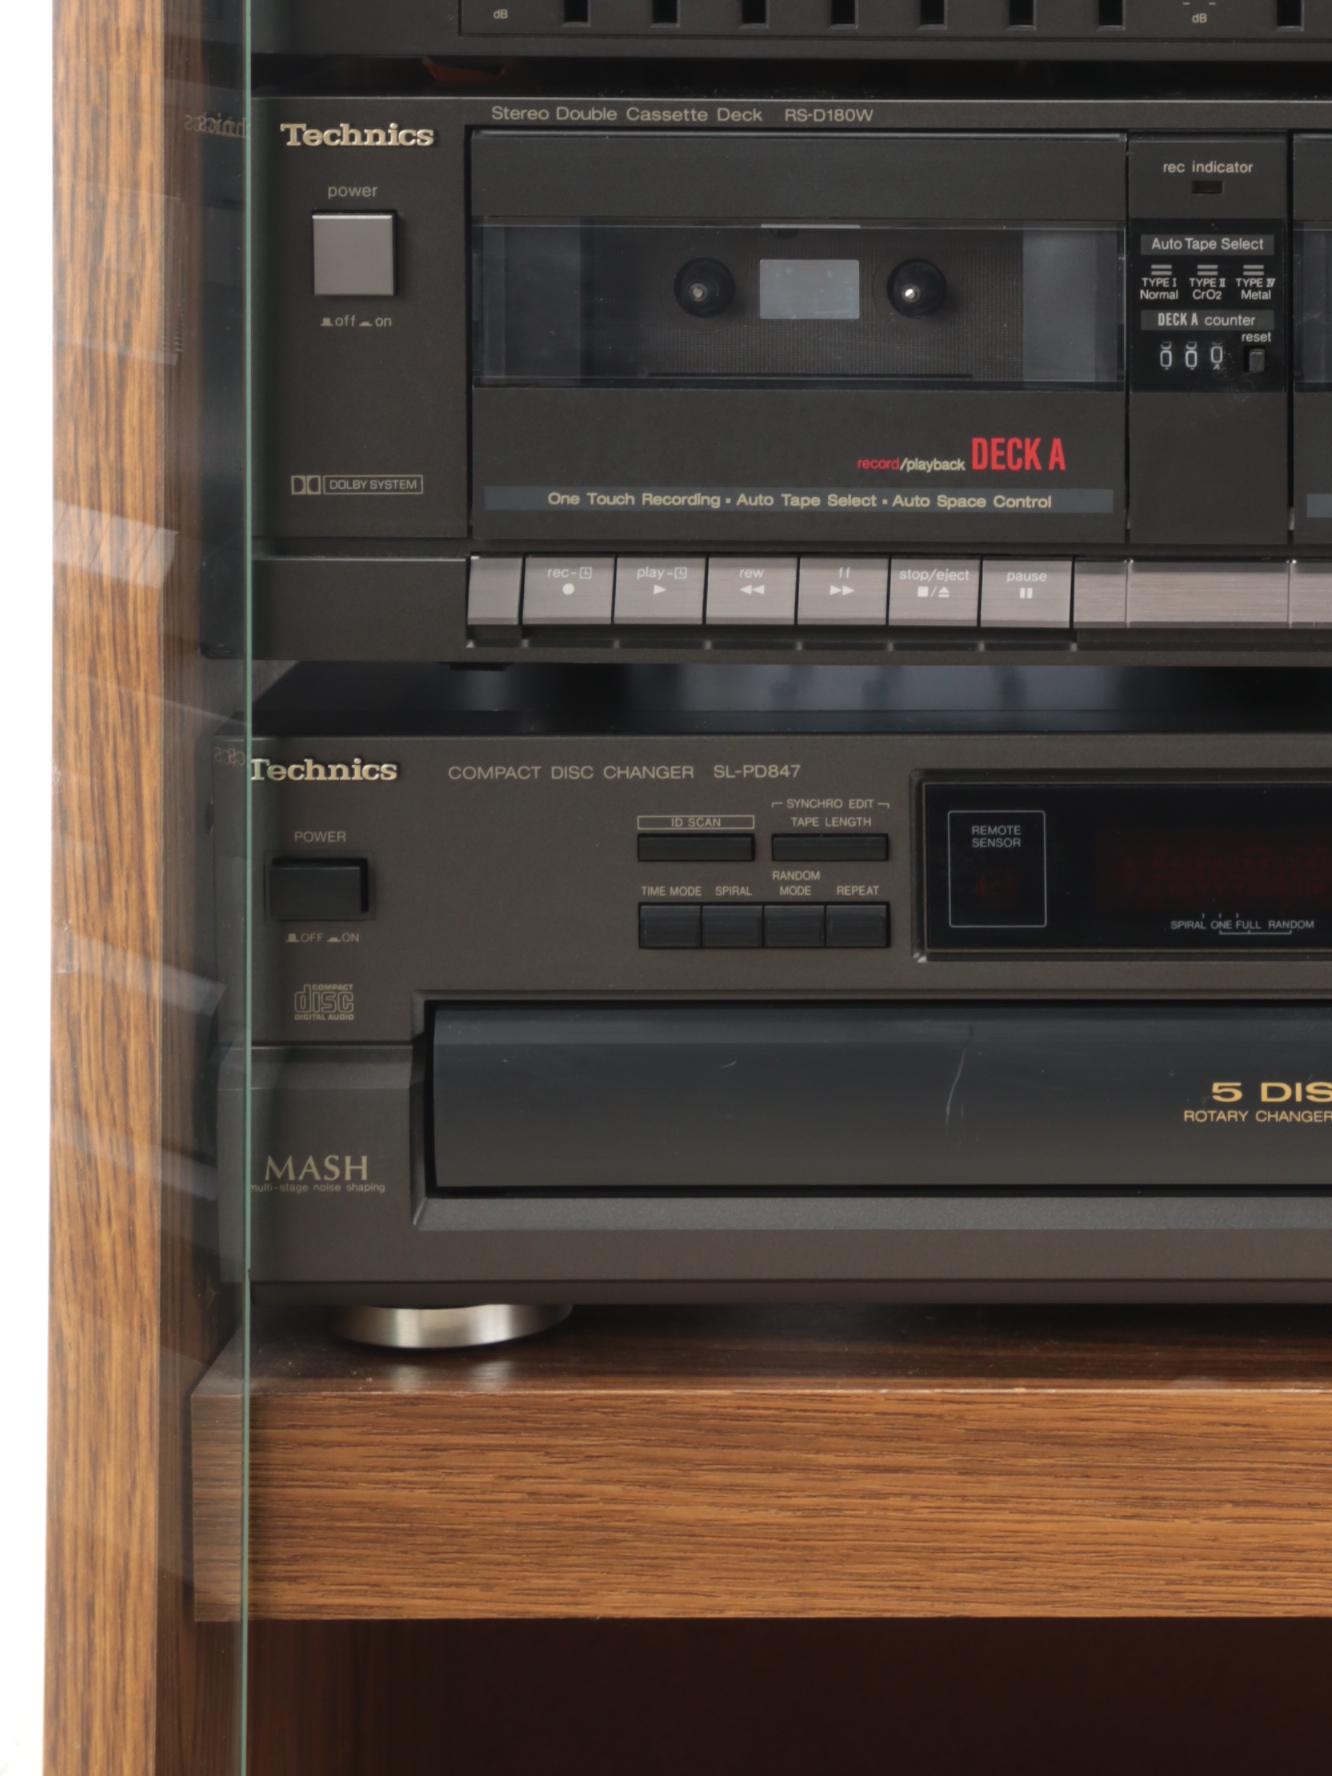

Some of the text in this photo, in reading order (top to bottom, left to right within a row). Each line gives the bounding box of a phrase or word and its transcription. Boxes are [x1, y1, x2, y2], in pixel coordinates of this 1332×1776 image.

[491, 105, 874, 122] Stereo Double Cassette Deck RS-D180W
[280, 122, 434, 147] Technics
[1163, 160, 1254, 174] rec indicator
[327, 185, 378, 200] power
[971, 437, 1042, 472] DECK
[1048, 437, 1066, 471] A
[329, 479, 417, 491] DOLBY SYSTEM
[547, 491, 1052, 511] One Touch Recording Auto Tape Select Auto Space Control
[899, 568, 970, 583] stop/eject
[1006, 570, 1047, 584] pause
[251, 758, 397, 782] Technics
[448, 763, 801, 780] COMPACT DISC CHANGER SL-PD847
[786, 798, 874, 810] SYNCHRO EDIT
[294, 830, 347, 843] POWER
[971, 824, 1021, 836] REMOTE
[971, 837, 1021, 849] SENSOR
[836, 885, 879, 896] REPEAT
[1212, 1082, 1243, 1103] 5
[1183, 1109, 1249, 1123] ROTARY
[265, 1154, 368, 1182] MASH
